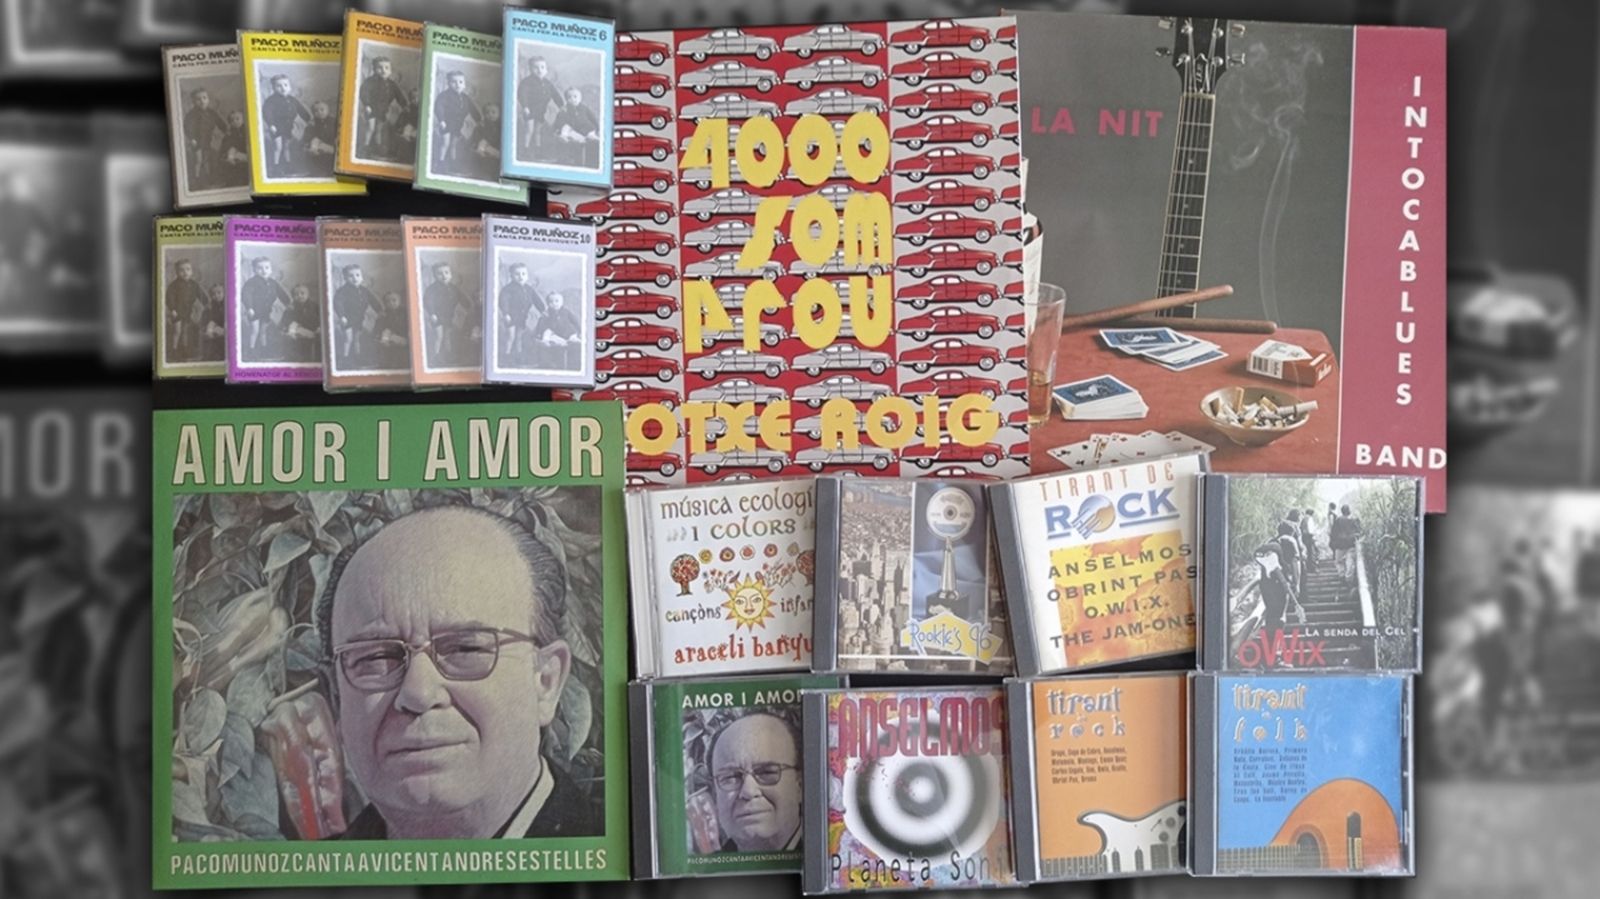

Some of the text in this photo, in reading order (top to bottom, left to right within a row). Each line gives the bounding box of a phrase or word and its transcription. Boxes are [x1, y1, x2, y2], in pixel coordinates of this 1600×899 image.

[357, 20, 393, 32] PACO
[432, 31, 469, 44] PACO
[512, 17, 598, 37] PACO MUÑOZ
[599, 30, 607, 41] 6
[172, 47, 239, 62] PACO MUÑ
[251, 38, 340, 48] PACO MUÑOZ
[1031, 106, 1163, 137] LA NIT
[679, 112, 890, 188] 4000
[160, 220, 224, 232] PACO MUÑ
[234, 223, 316, 234] PACO MUÑO
[324, 228, 361, 237] PACO
[412, 224, 483, 235] PACO MUÑ
[493, 224, 580, 239] PACO MUÑOZ
[580, 233, 591, 244] 10
[1395, 75, 1428, 405] INTOCABLUES
[626, 393, 1000, 457] OTXE ROIG
[171, 415, 604, 486] AMOR I AMOR
[1355, 443, 1447, 469] BAND
[1039, 463, 1175, 501] TIRANT DE
[661, 485, 813, 520] música ecologí
[1048, 543, 1192, 579] ANSELMOS
[1047, 565, 1198, 602] OBRINT PAS
[1084, 595, 1170, 620] O.W.I.X.
[1050, 614, 1197, 649] THE JAM-ONE
[674, 632, 813, 664] araceli banyu
[682, 692, 735, 709] AMOR
[741, 692, 746, 705] I
[1047, 686, 1124, 715] tirant
[1232, 683, 1306, 711] tirant
[1049, 714, 1126, 739] rock
[1233, 716, 1306, 742] folk
[831, 851, 930, 884] Planeta
